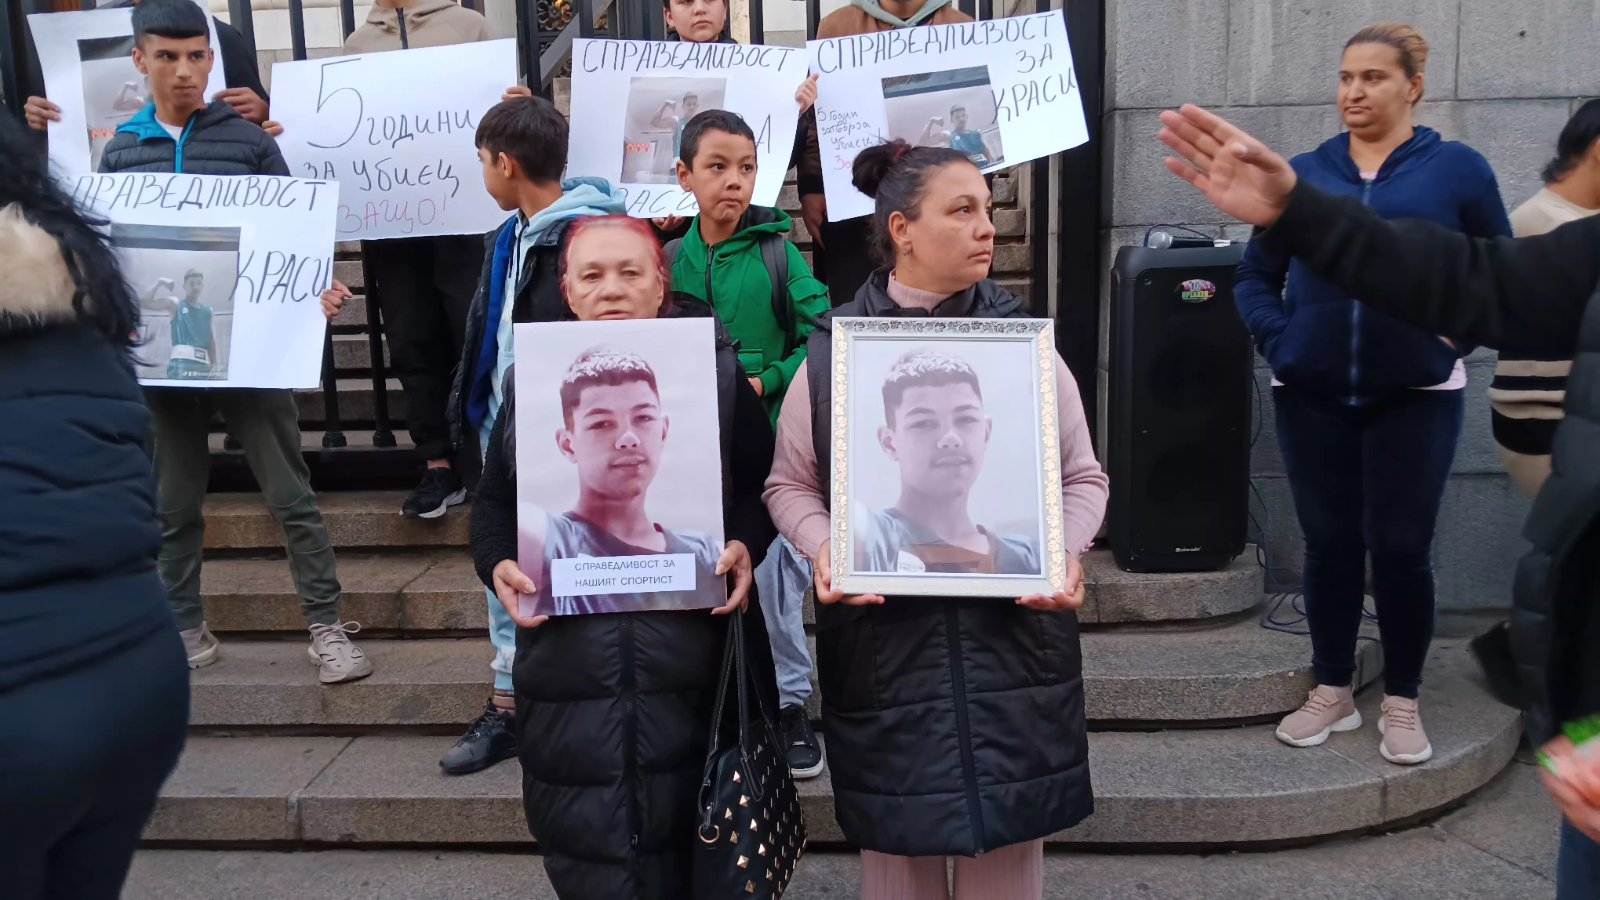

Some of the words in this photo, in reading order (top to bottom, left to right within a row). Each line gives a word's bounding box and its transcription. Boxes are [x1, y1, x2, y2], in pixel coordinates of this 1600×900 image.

[582, 39, 795, 73] СПРАВЕДЛИВОСТ
[817, 13, 1056, 74] СПРАВЕДЛИВОСТ
[1016, 43, 1053, 74] ЗА
[307, 57, 362, 149] 5
[990, 67, 1076, 125] КРАСИ
[816, 107, 827, 122] 5
[303, 161, 336, 179] ЗА
[66, 173, 329, 212] ПРАВЕДЛИВОСТ
[229, 250, 331, 304] КРАСИ
[574, 559, 659, 571] СПРАВЕДЛИВОСТ
[663, 559, 676, 568] ЗА
[575, 577, 617, 588] НАШИЯТ
[620, 575, 673, 587] СПОРТИСТ
